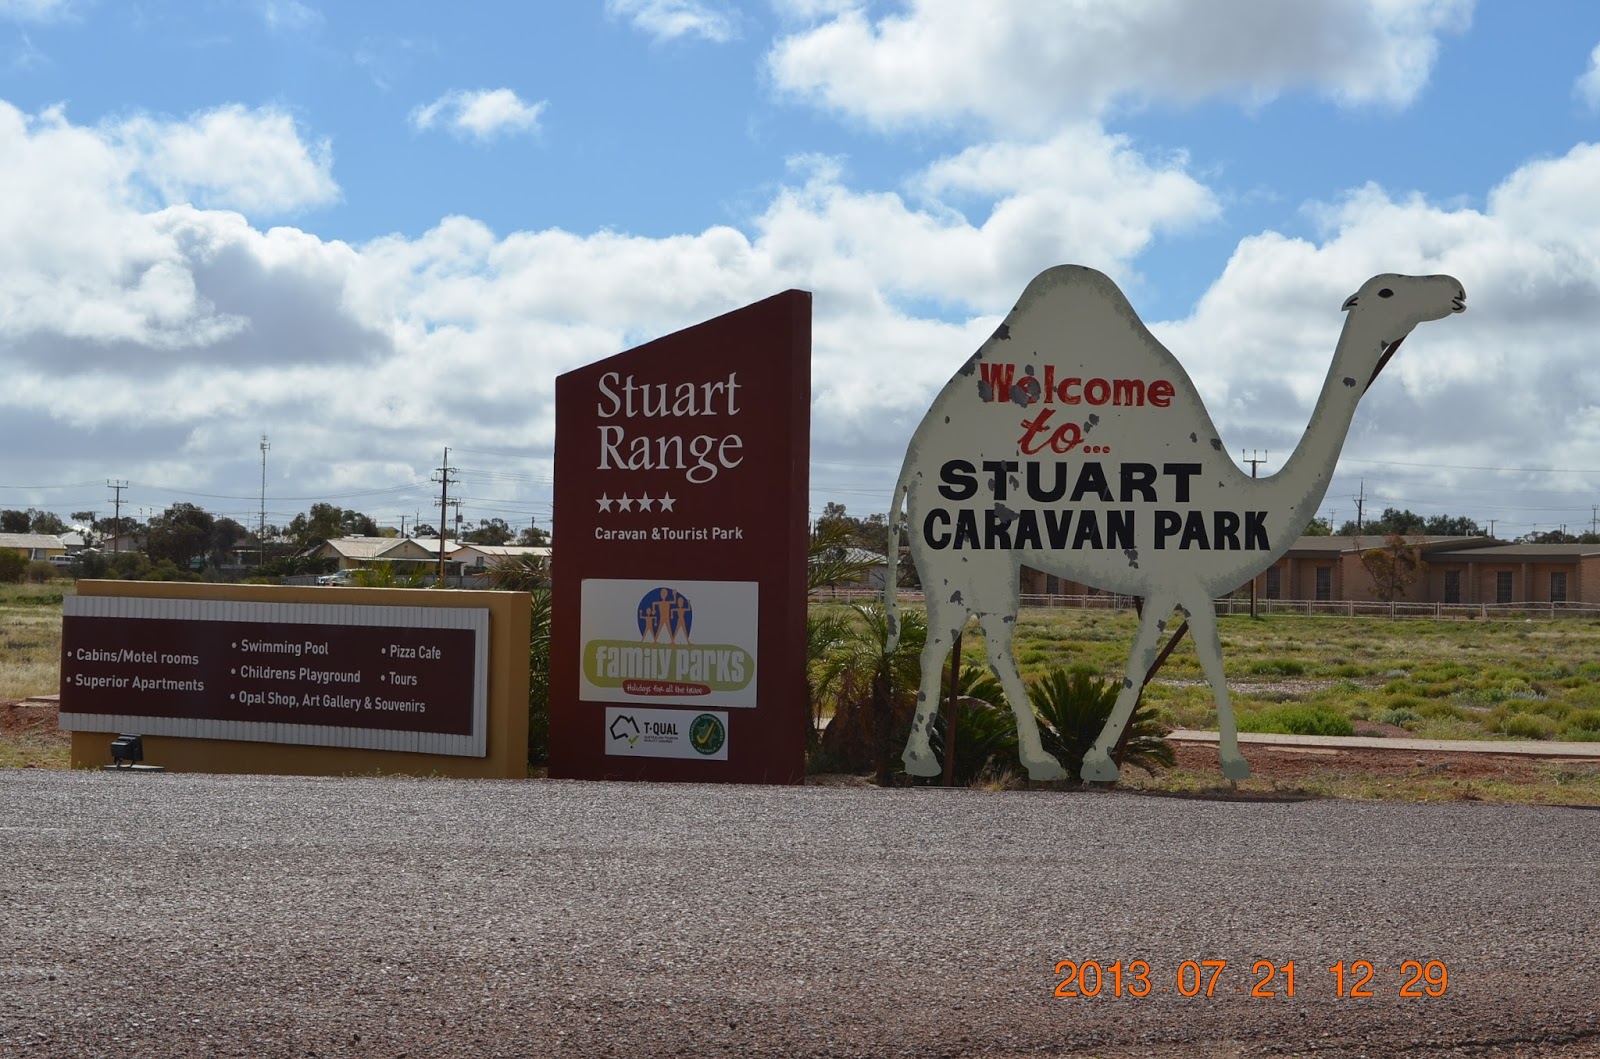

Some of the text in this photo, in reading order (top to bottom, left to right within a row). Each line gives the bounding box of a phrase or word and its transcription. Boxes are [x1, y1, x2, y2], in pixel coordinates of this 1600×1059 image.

[597, 371, 742, 418] Stuart
[979, 363, 1176, 408] Welcome
[596, 425, 744, 484] Range
[937, 459, 1203, 503] STUART
[594, 526, 647, 540] Caravan
[712, 526, 744, 540] Park
[923, 508, 1271, 551] CARAVAN PARK
[76, 648, 199, 665] Cabins/Motel rooms
[241, 639, 329, 657] Swimming Pool
[390, 644, 441, 660] Pizza Cafe
[595, 645, 672, 680] family
[75, 674, 205, 692] Superior Apartments
[240, 665, 361, 685] Childrens Playground
[389, 671, 418, 686] Tours
[239, 690, 426, 713] Opal Shop, Art Gallery & Souvenirs
